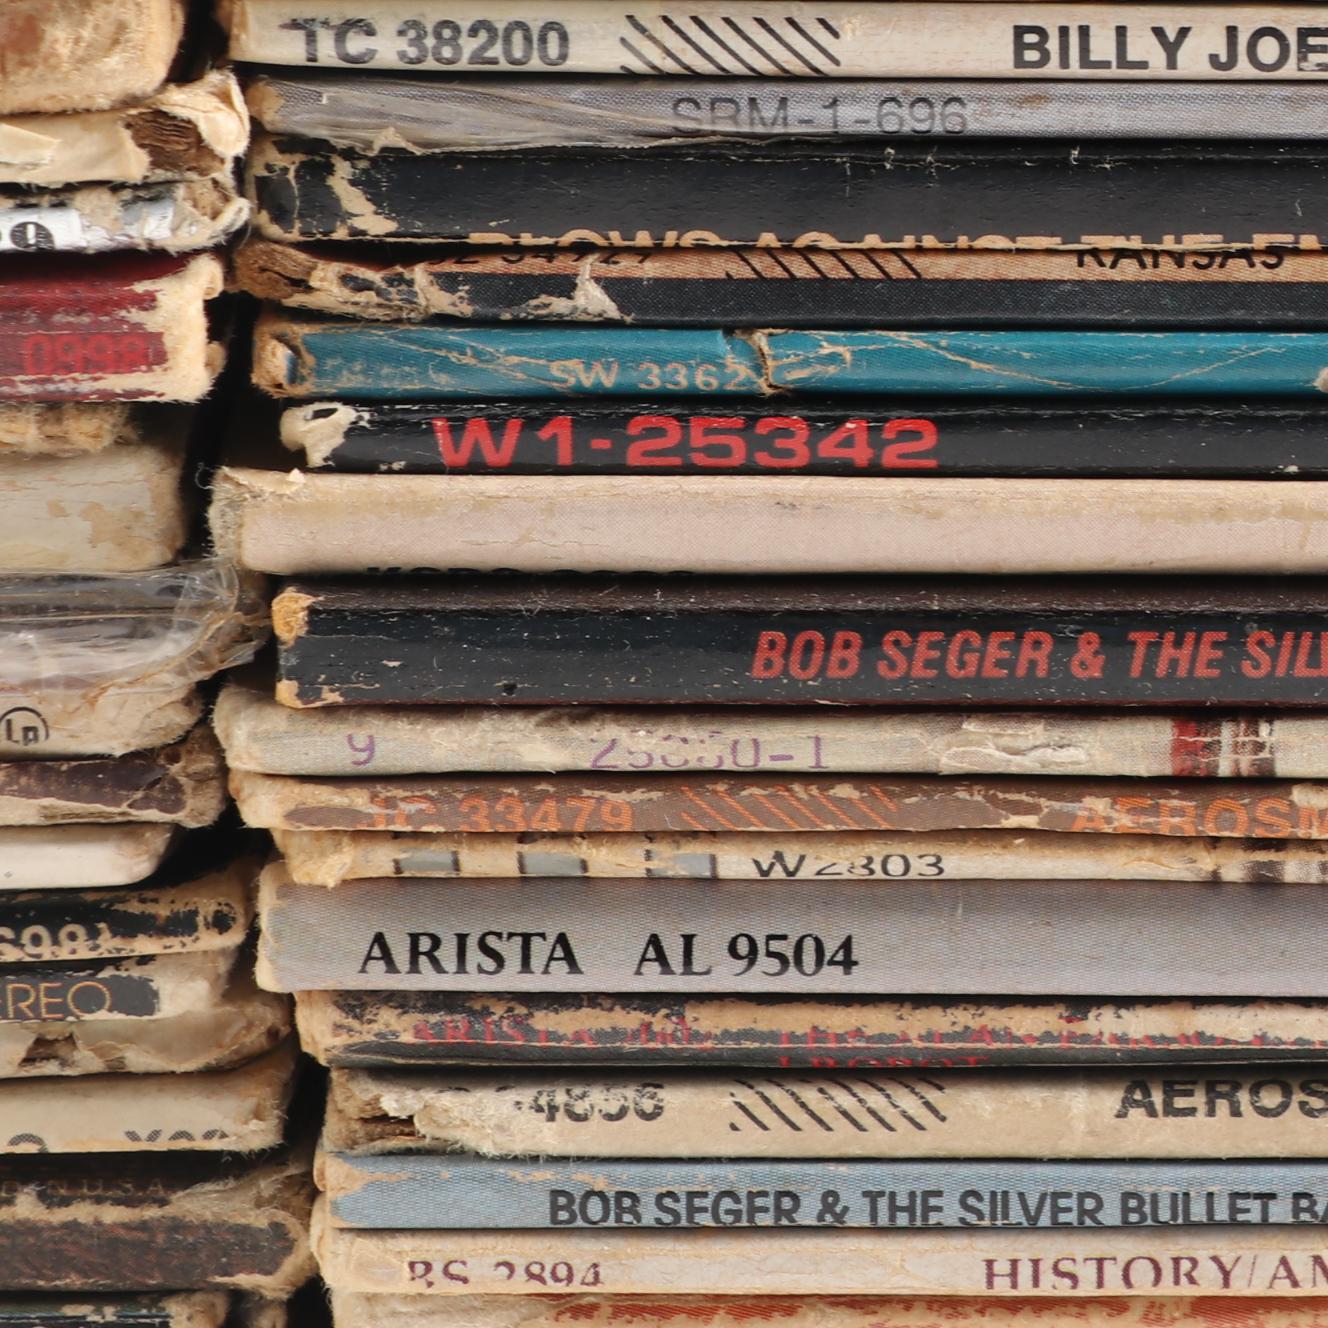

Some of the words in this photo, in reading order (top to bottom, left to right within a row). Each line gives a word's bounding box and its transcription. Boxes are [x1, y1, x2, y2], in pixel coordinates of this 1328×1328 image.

[293, 18, 378, 65] TC
[396, 18, 571, 66] 38200
[1011, 23, 1193, 71] BILLY
[671, 95, 969, 136] SRM-1-696
[431, 415, 940, 469] W1-25342
[750, 629, 865, 680] BOB
[876, 629, 1054, 681] SEGER
[1069, 631, 1106, 681] &
[1127, 631, 1229, 680] THE
[458, 794, 636, 832] 33479
[358, 930, 585, 976] ARISTA
[633, 932, 712, 976] AL
[726, 932, 860, 977] 9504
[0, 980, 112, 1020] REO
[548, 1190, 642, 1227] BOB
[653, 1190, 800, 1227] SEGER
[815, 1190, 851, 1226] &
[861, 1190, 944, 1227] THE
[958, 1190, 1105, 1228] SILVER
[1119, 1190, 1278, 1227] BULLET
